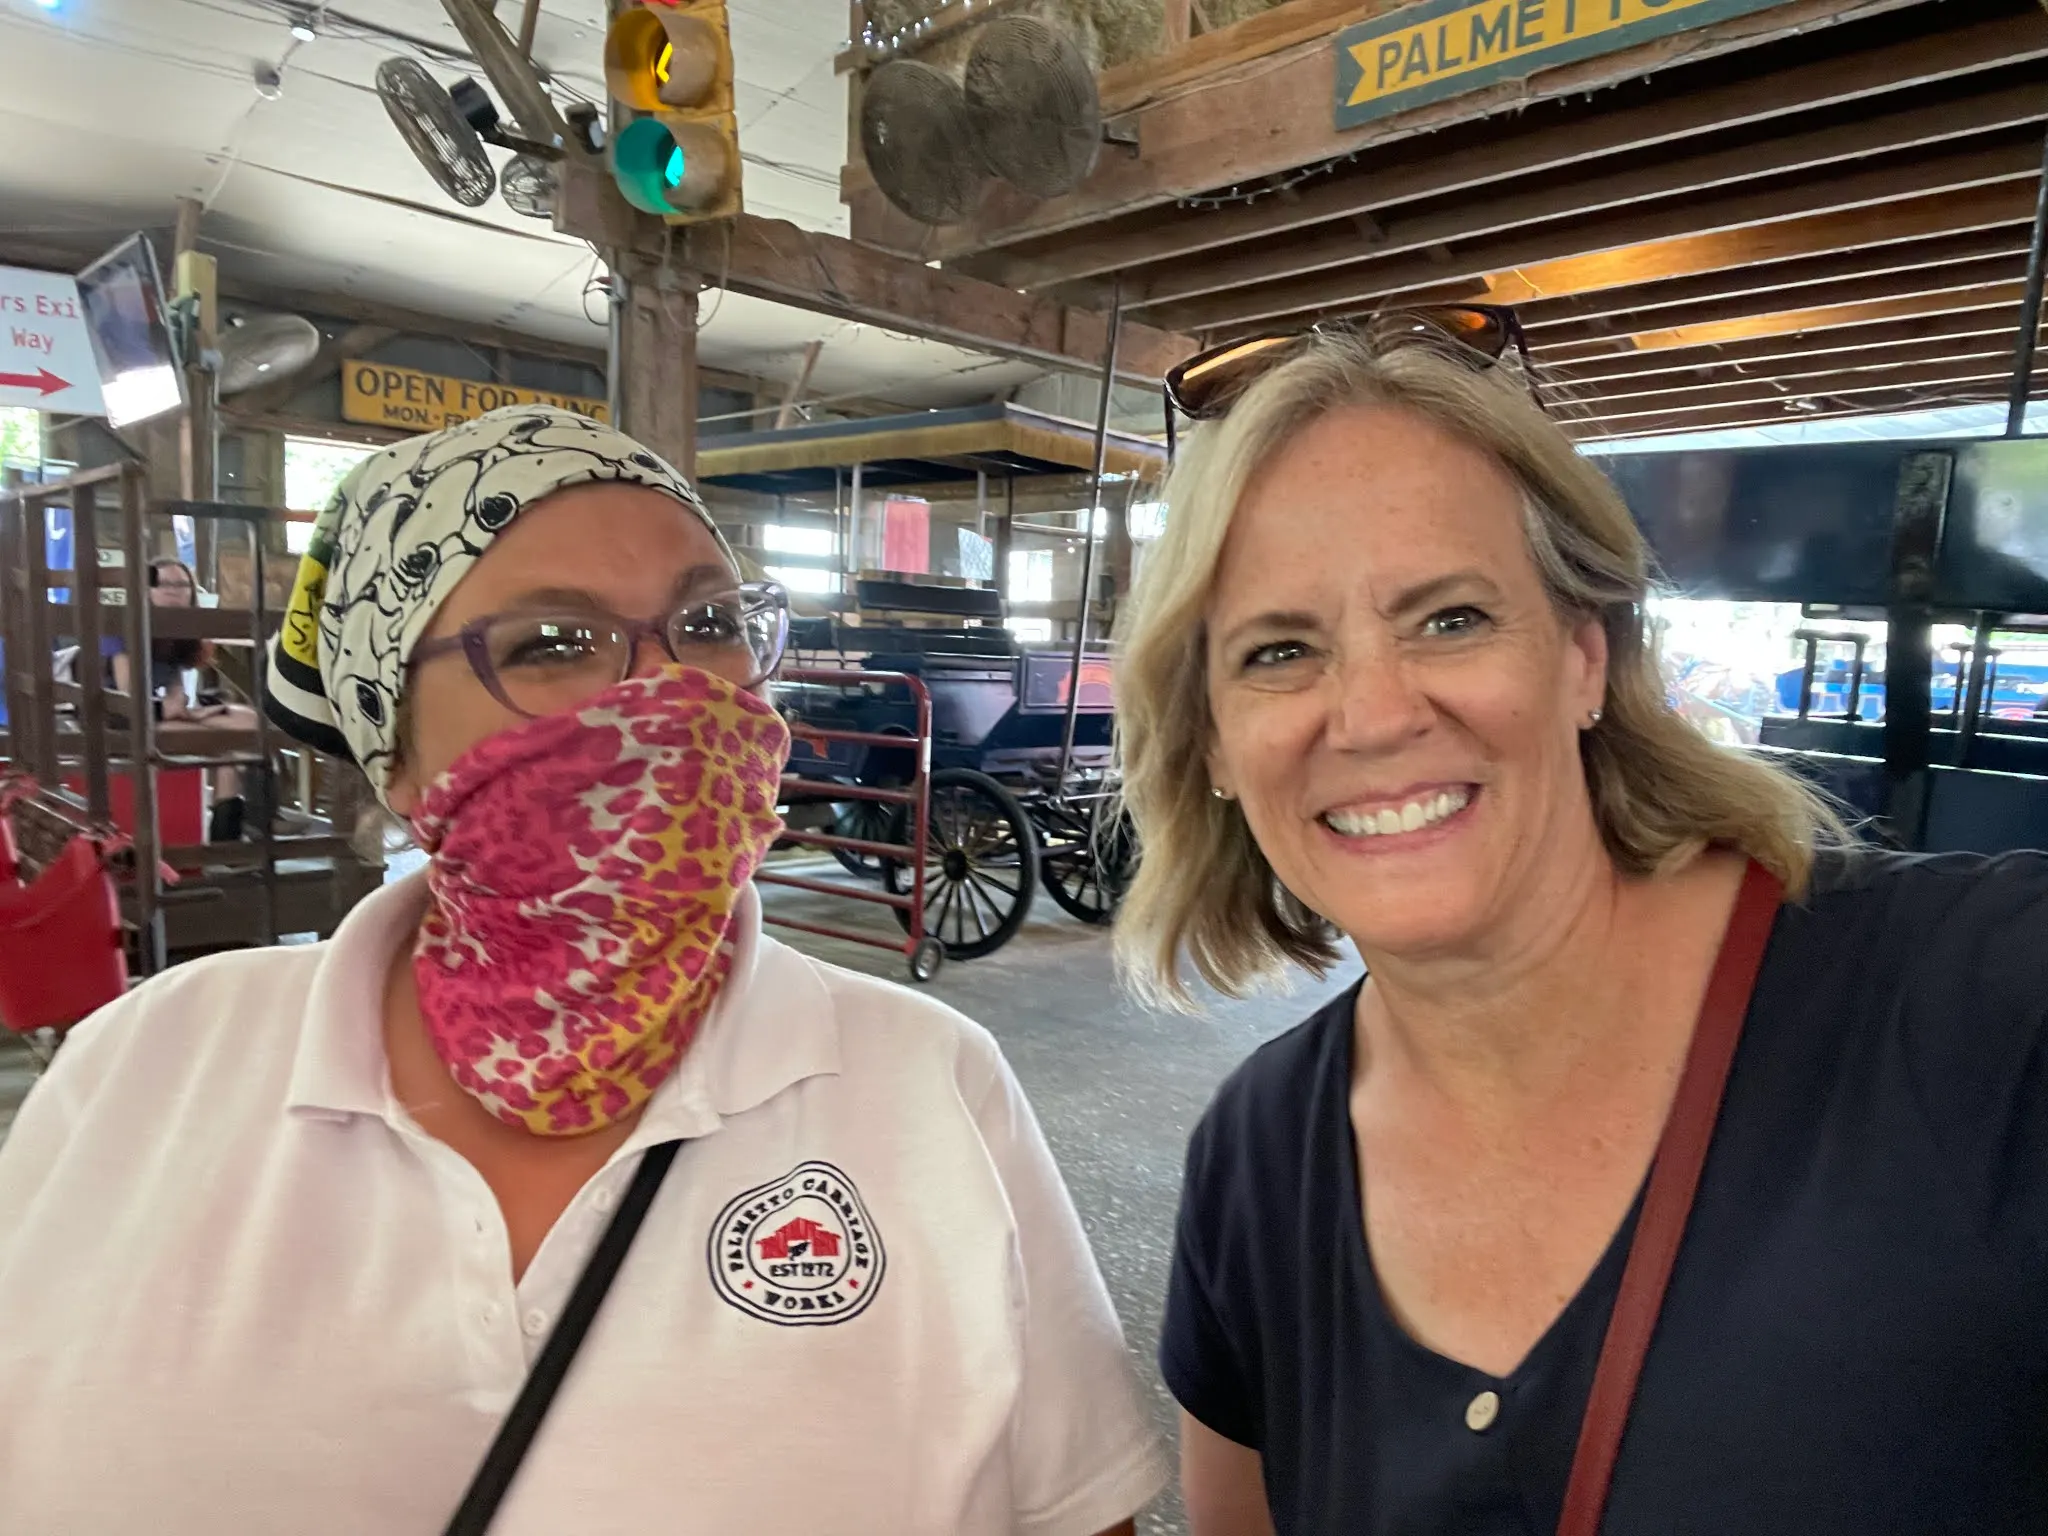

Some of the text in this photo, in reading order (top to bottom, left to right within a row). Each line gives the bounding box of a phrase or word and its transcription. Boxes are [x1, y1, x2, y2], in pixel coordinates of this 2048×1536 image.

[1376, 0, 1674, 89] PALMET
[10, 326, 54, 355] Way
[355, 367, 445, 406] OPEN
[727, 1178, 869, 1272] PALMETTO CARRIAGE
